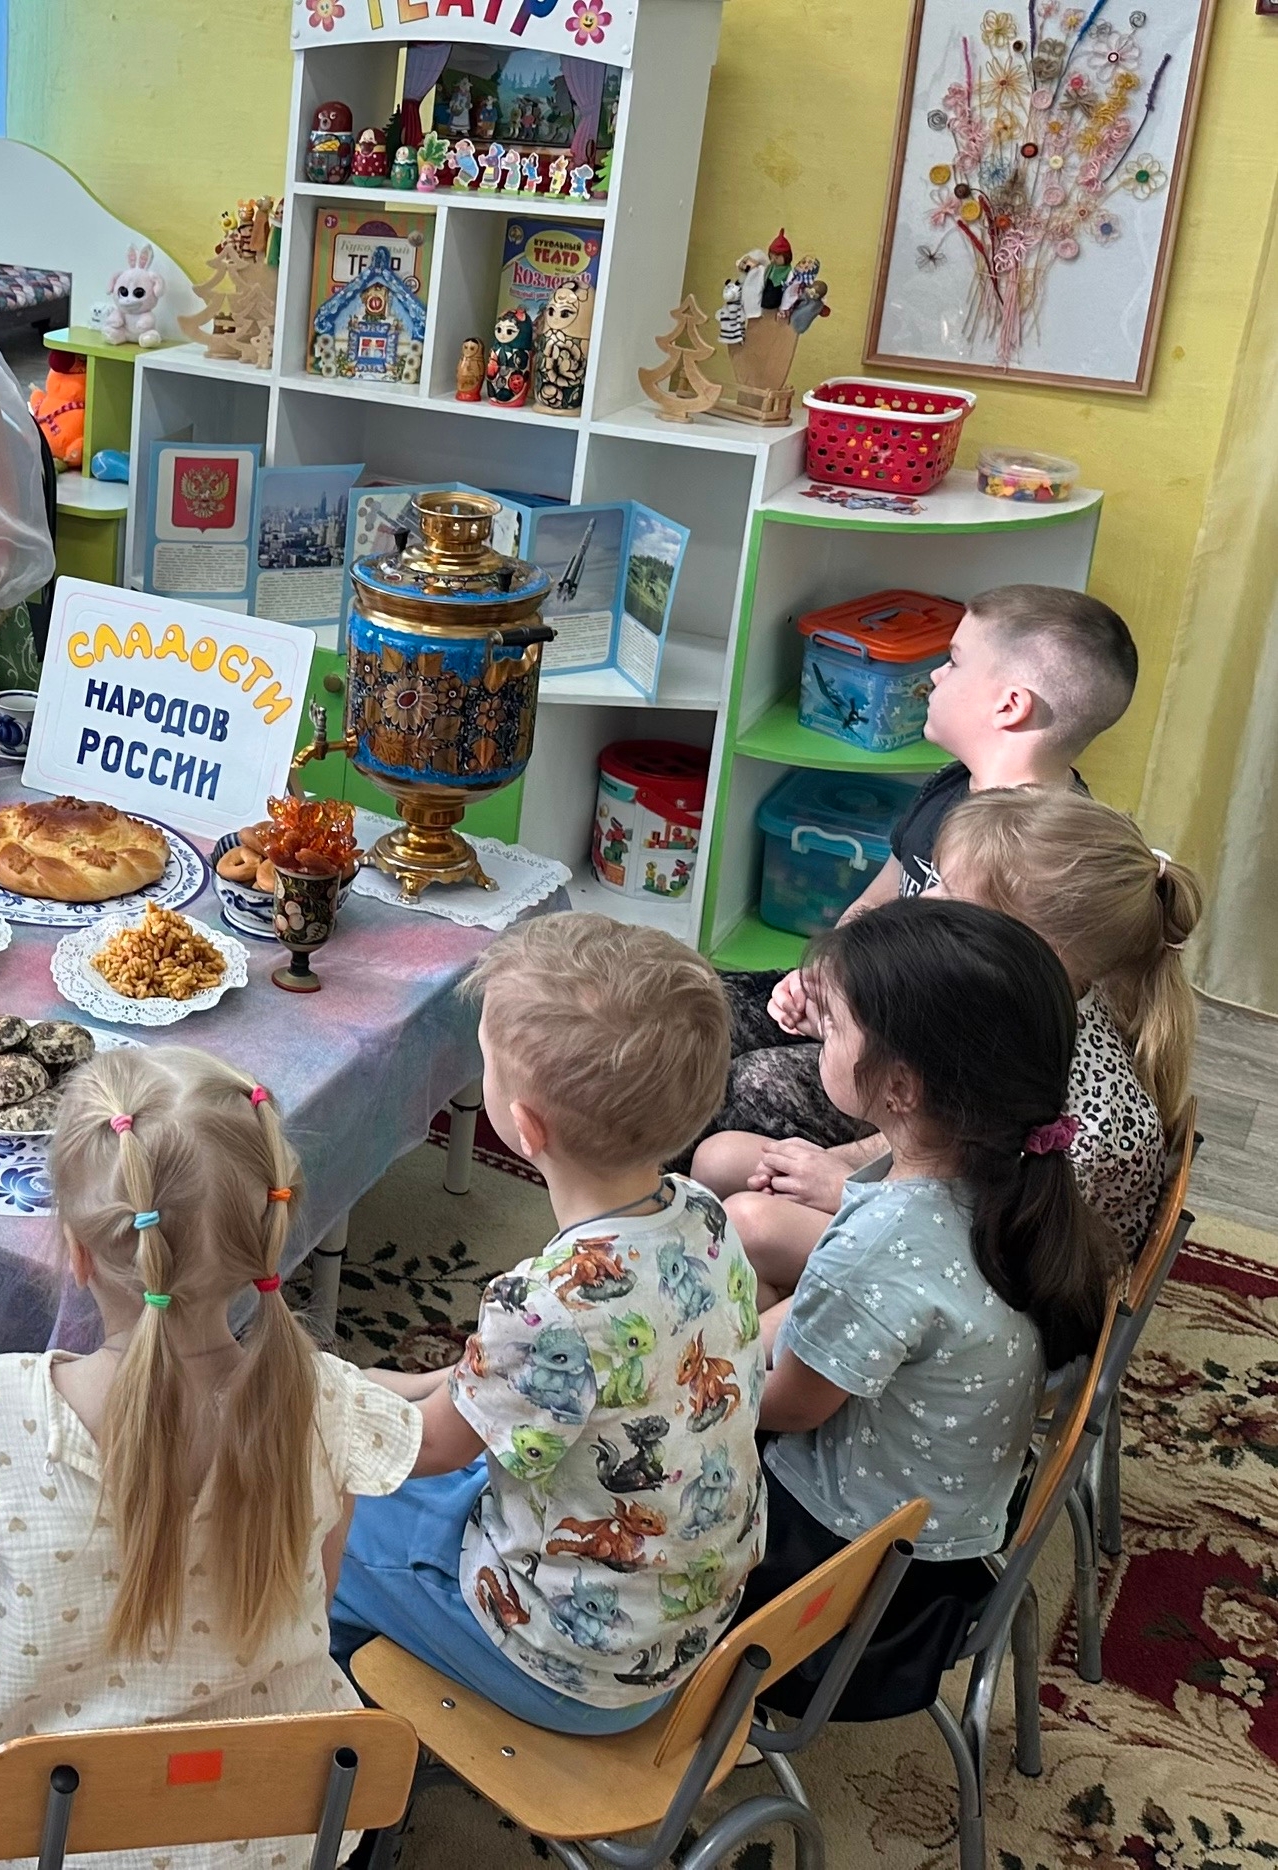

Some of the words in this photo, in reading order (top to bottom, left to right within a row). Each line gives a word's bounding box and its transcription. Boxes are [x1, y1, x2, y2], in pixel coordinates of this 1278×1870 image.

[340, 239, 410, 256] Куконый
[533, 239, 582, 252] КУКОЛЬНЫЙ
[533, 247, 580, 267] ТЕАТР
[348, 253, 402, 276] ТЕР
[68, 622, 292, 725] СЛАДОСТИ
[85, 678, 230, 742] НАРОДОВ
[76, 727, 221, 801] РОССИИ
